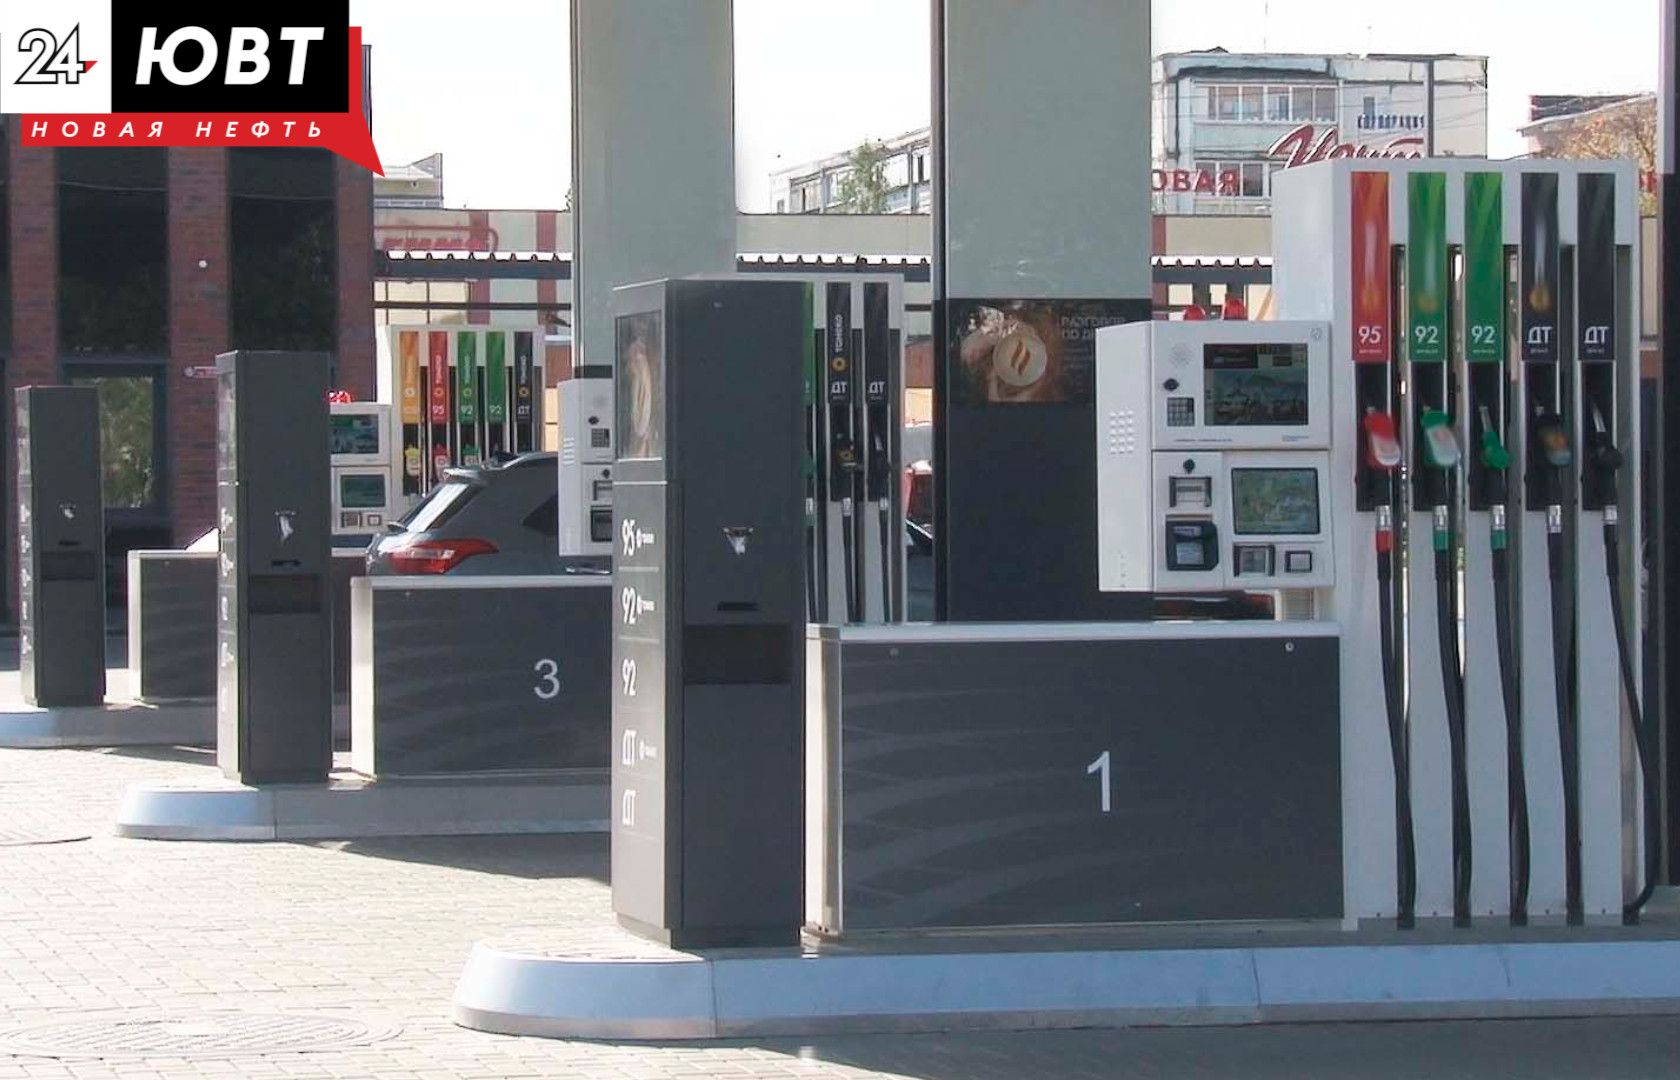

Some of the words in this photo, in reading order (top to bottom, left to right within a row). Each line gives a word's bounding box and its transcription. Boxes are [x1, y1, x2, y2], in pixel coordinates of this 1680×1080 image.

[1358, 325, 1382, 344] 95
[1414, 325, 1440, 344] 92
[1471, 325, 1496, 344] 92
[1527, 326, 1553, 344] ДТ
[1584, 326, 1609, 344] ДТ
[831, 381, 848, 395] ДТ
[869, 381, 886, 395] ДТ
[622, 518, 635, 556] 95
[622, 587, 636, 625] 92
[534, 659, 560, 699] 3
[622, 658, 636, 696] 92
[622, 729, 637, 766] ДТ
[1087, 750, 1111, 812] 1
[622, 789, 636, 827] ДТ
